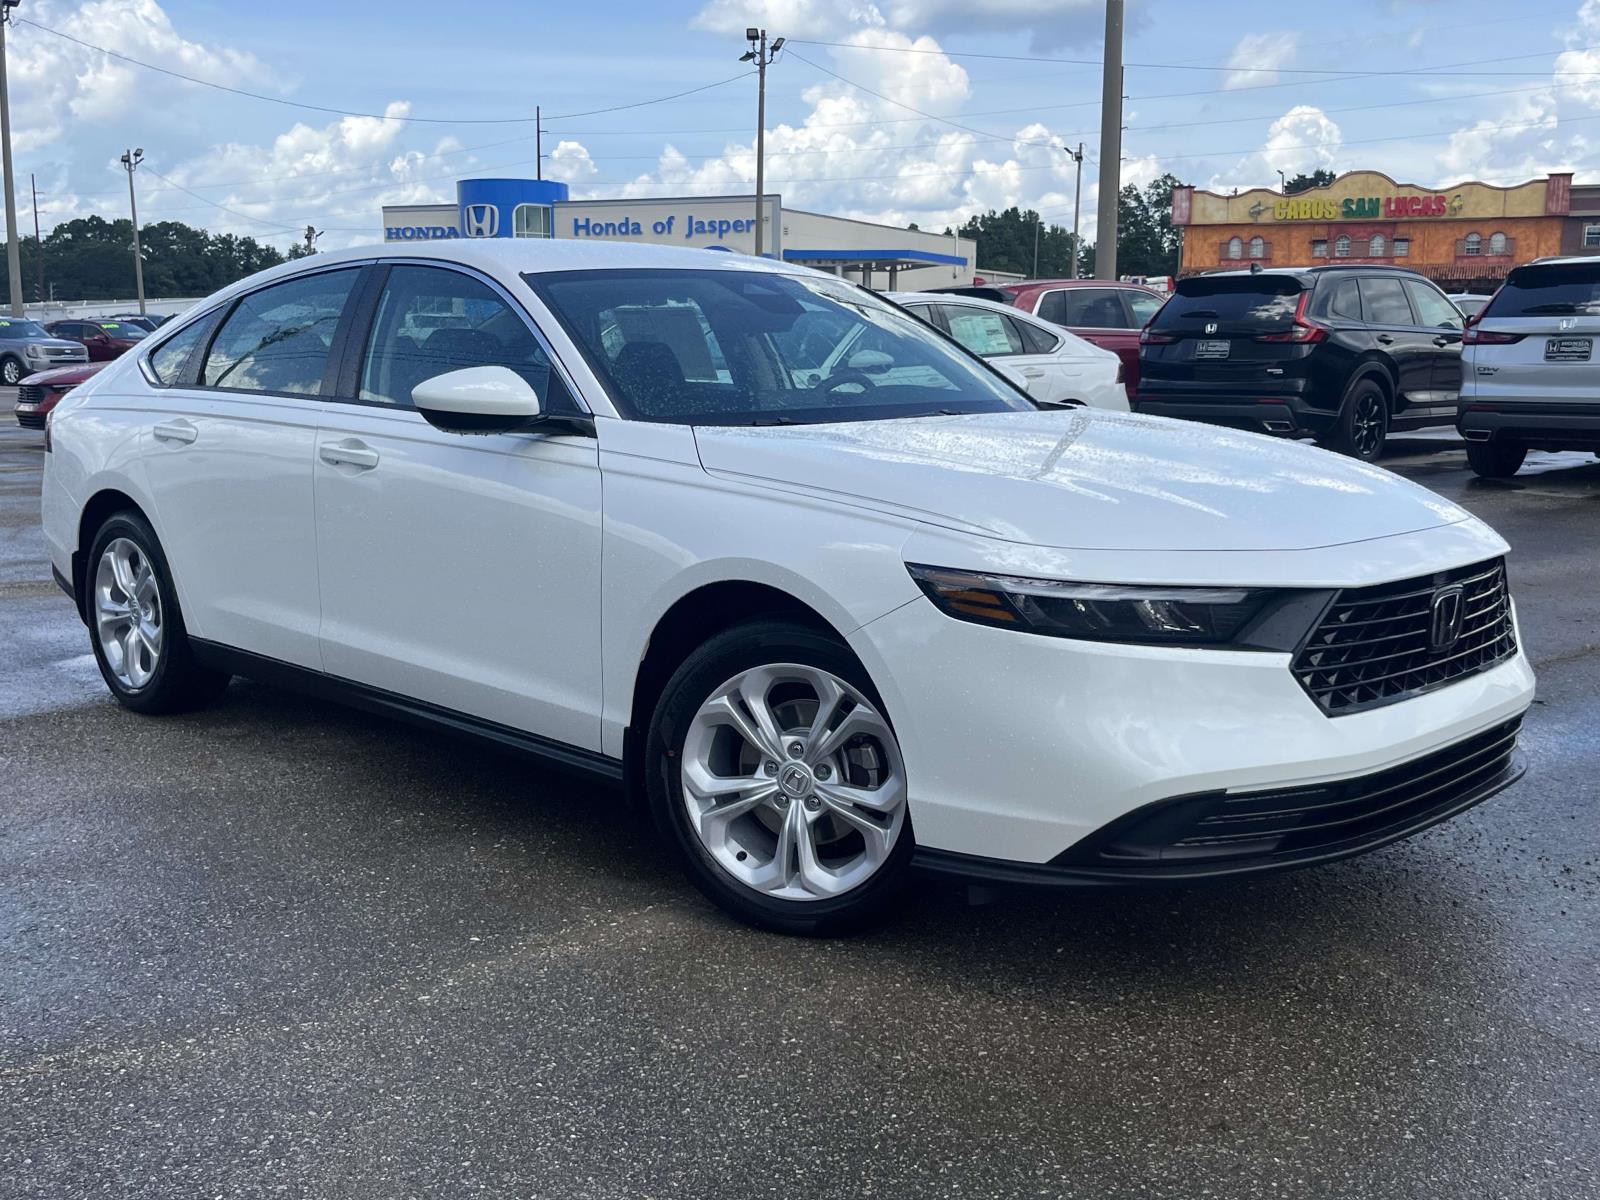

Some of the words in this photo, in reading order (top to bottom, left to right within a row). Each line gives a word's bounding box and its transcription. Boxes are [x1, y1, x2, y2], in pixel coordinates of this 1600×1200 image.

[1274, 199, 1338, 220] CABOS
[1342, 197, 1380, 218] SAN
[1384, 195, 1447, 216] LUCAS
[386, 226, 460, 240] HONDA
[573, 216, 643, 237] Honda
[652, 215, 675, 235] of
[685, 215, 756, 239] Jasper
